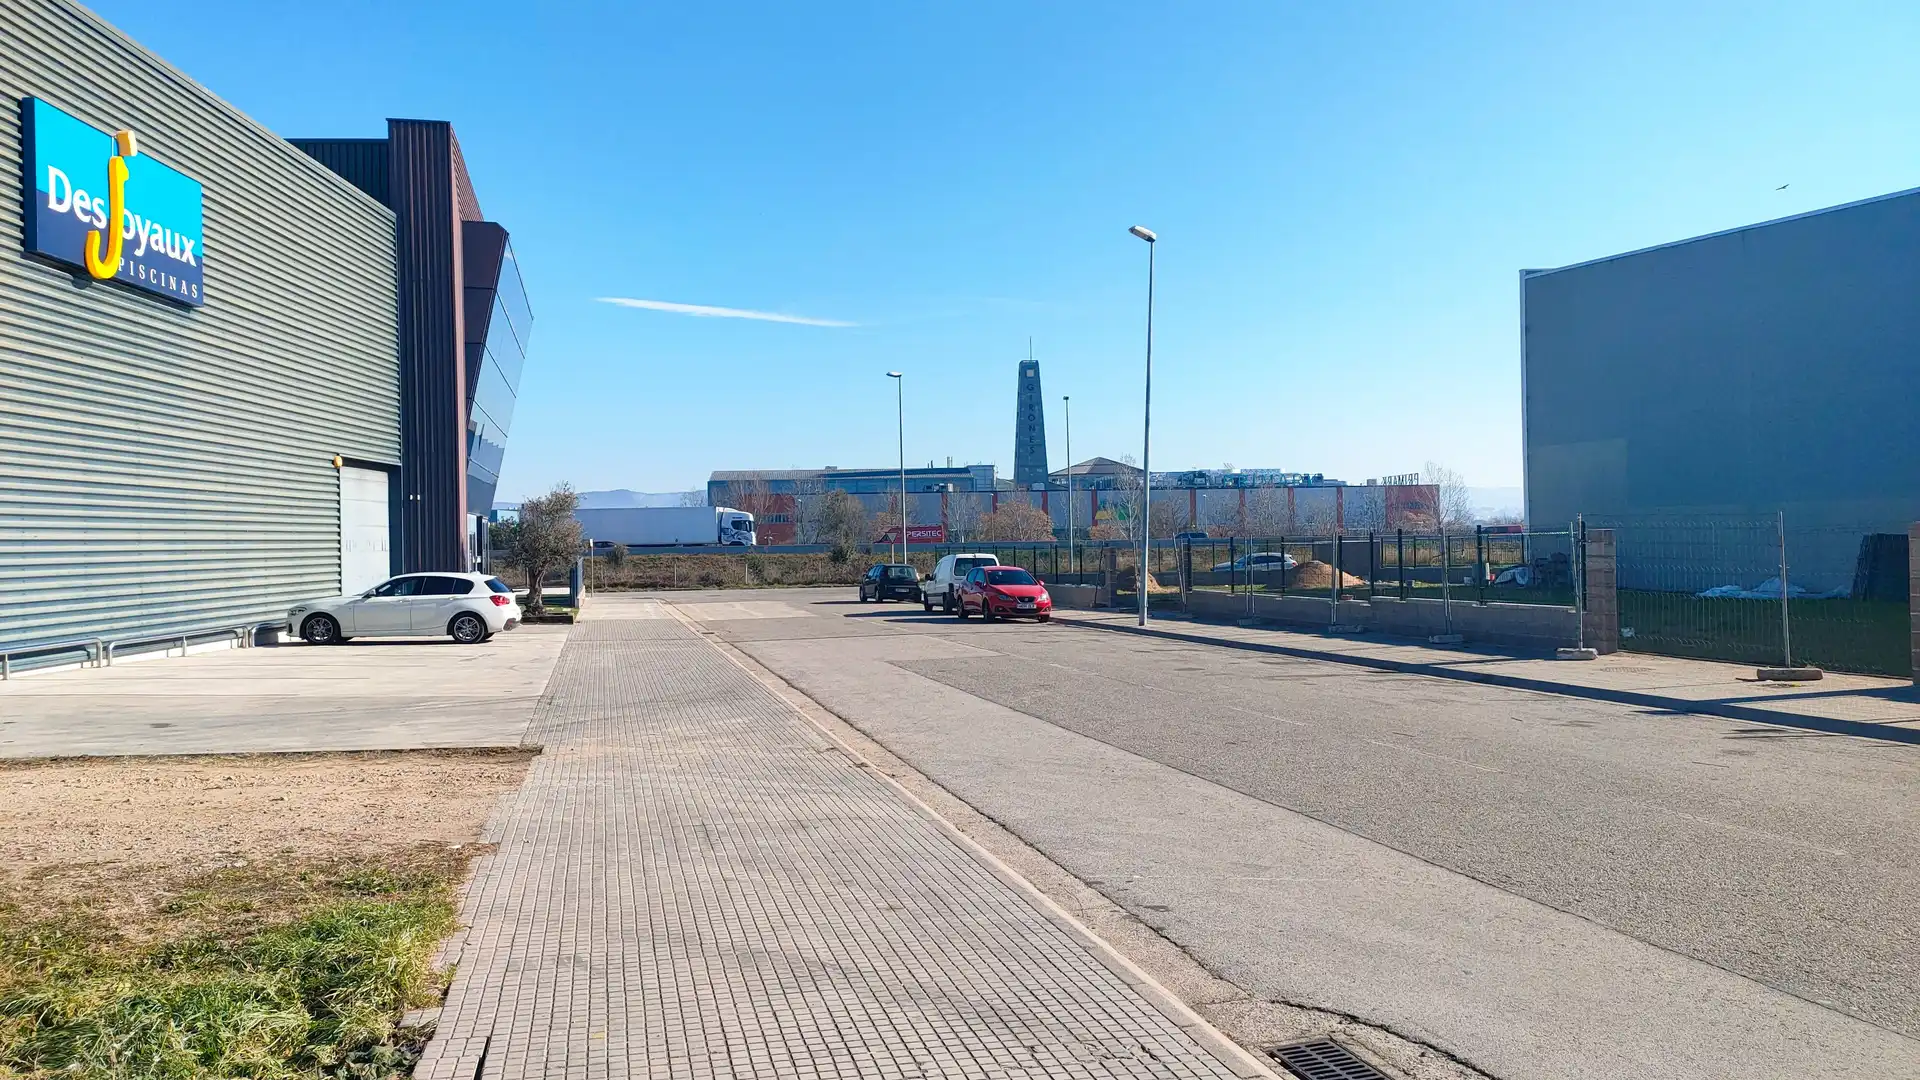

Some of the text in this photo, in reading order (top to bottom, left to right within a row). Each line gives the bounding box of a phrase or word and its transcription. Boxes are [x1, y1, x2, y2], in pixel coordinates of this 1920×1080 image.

[118, 256, 198, 299] PISCINAS
[1026, 383, 1037, 455] GIRONES
[906, 529, 942, 538] PERSITEC
